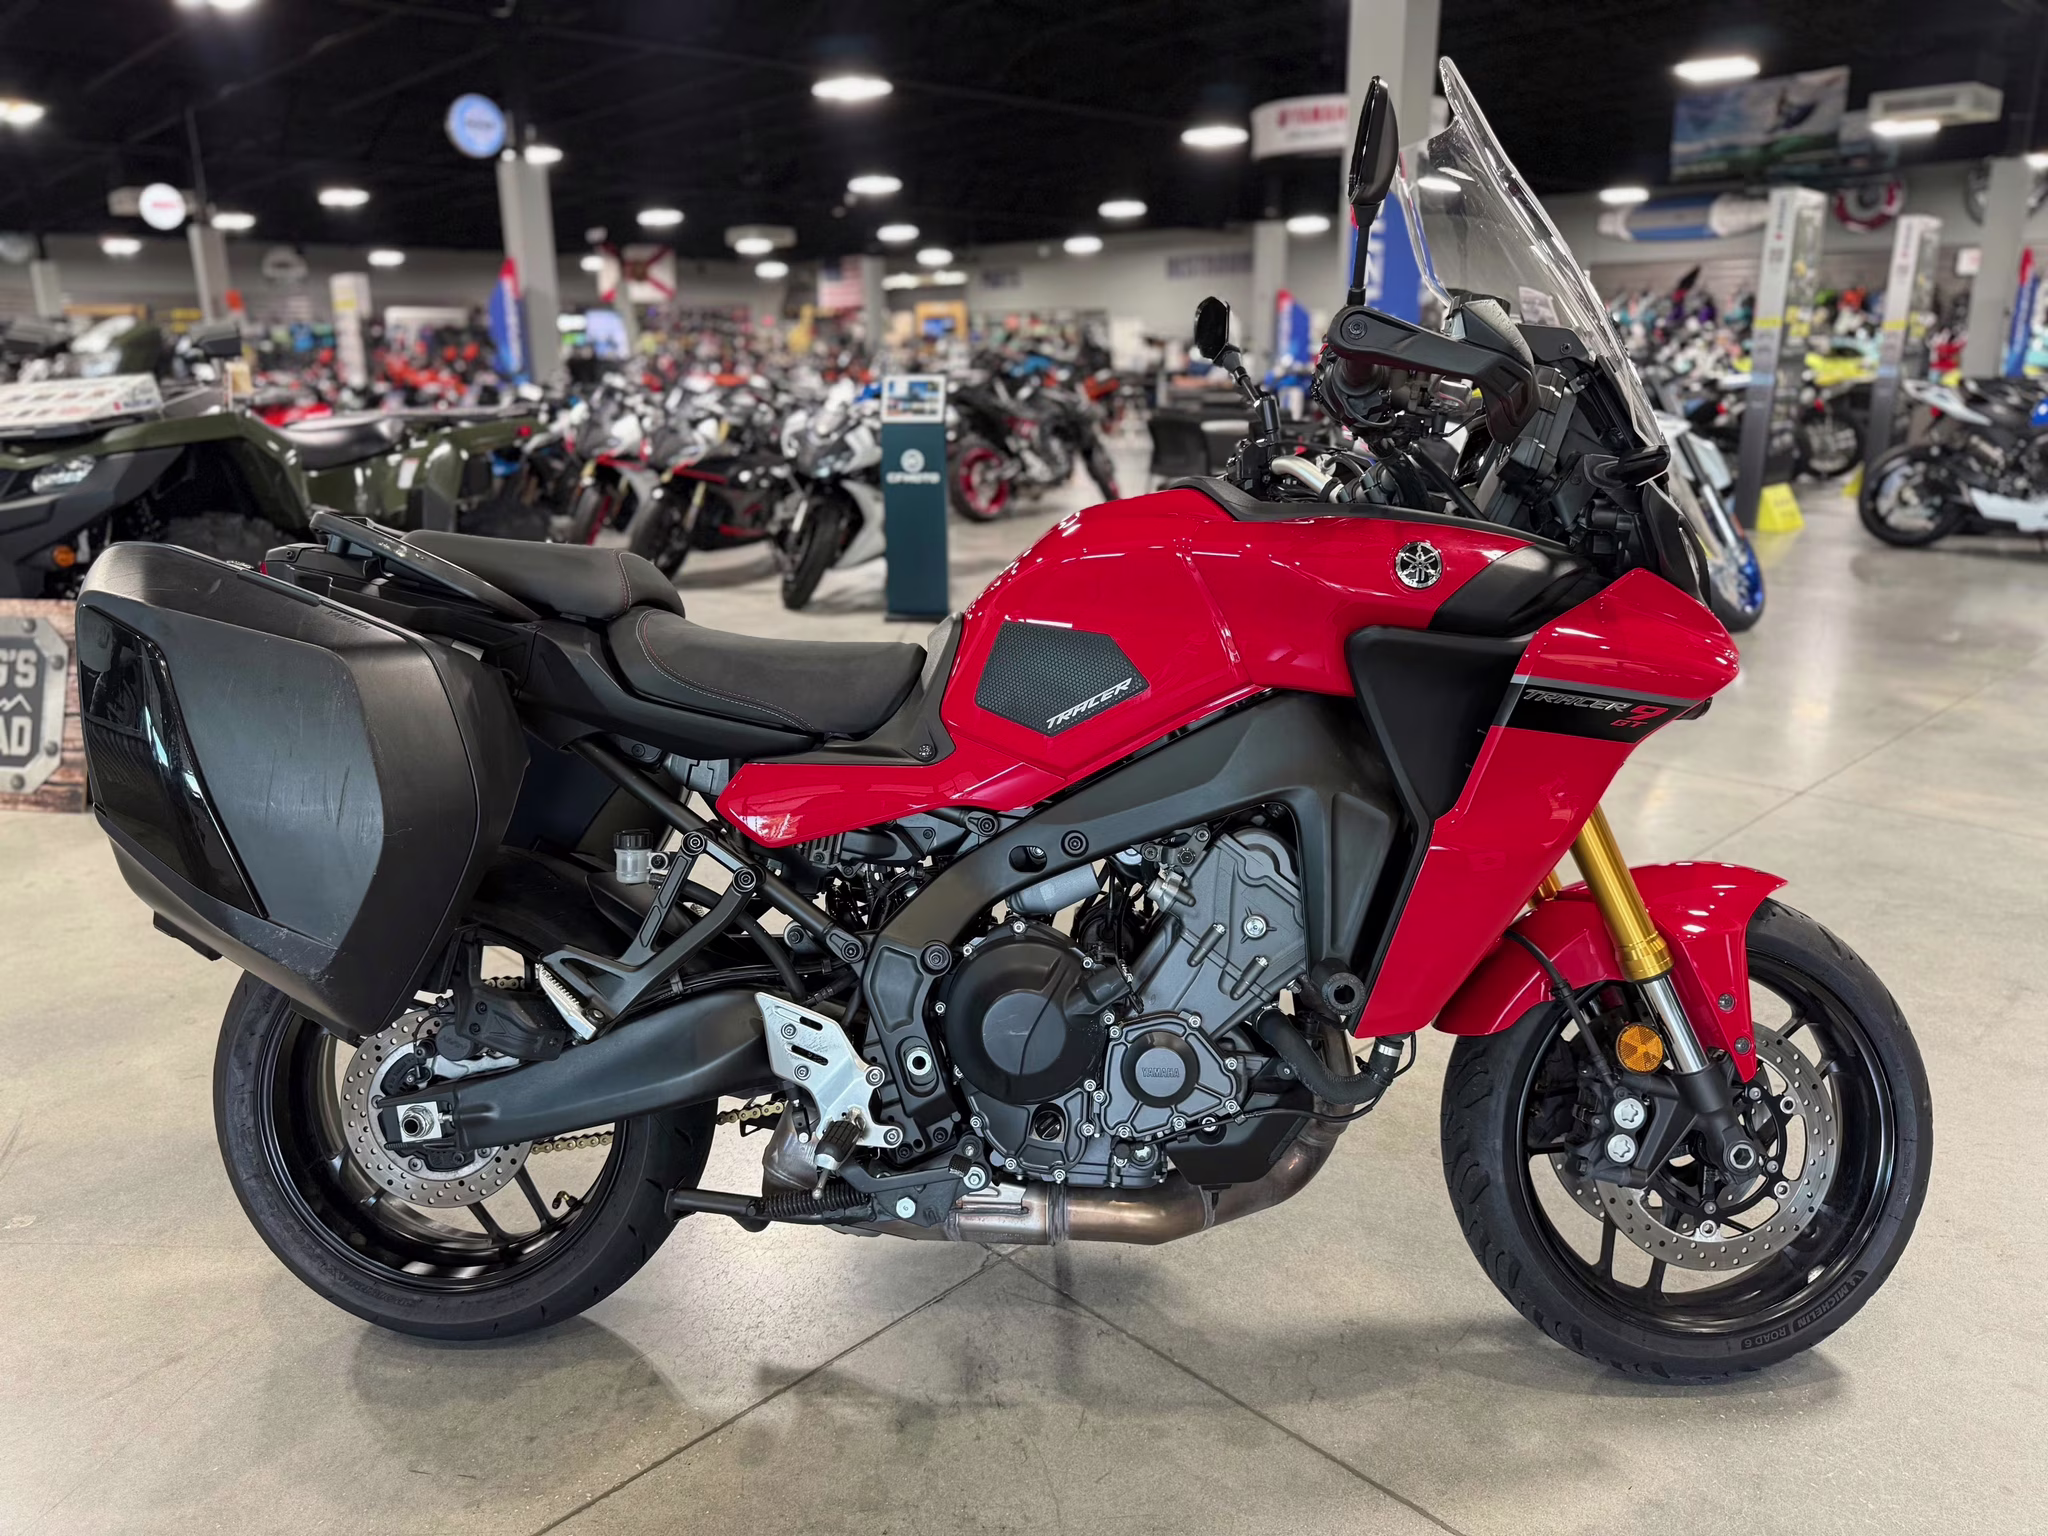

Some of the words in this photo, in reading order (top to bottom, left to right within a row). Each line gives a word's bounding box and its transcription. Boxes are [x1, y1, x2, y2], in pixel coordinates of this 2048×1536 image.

[326, 610, 372, 630] YAMAHA
[1046, 677, 1132, 729] TRACER
[1523, 689, 1634, 713] TRACER
[1626, 704, 1669, 721] 9
[1609, 718, 1649, 728] GT
[1141, 1067, 1180, 1078] YAMAHA
[1797, 1281, 1850, 1328] MICHELIN
[1744, 1337, 1752, 1348] 6
[1755, 1326, 1788, 1345] ROAD
